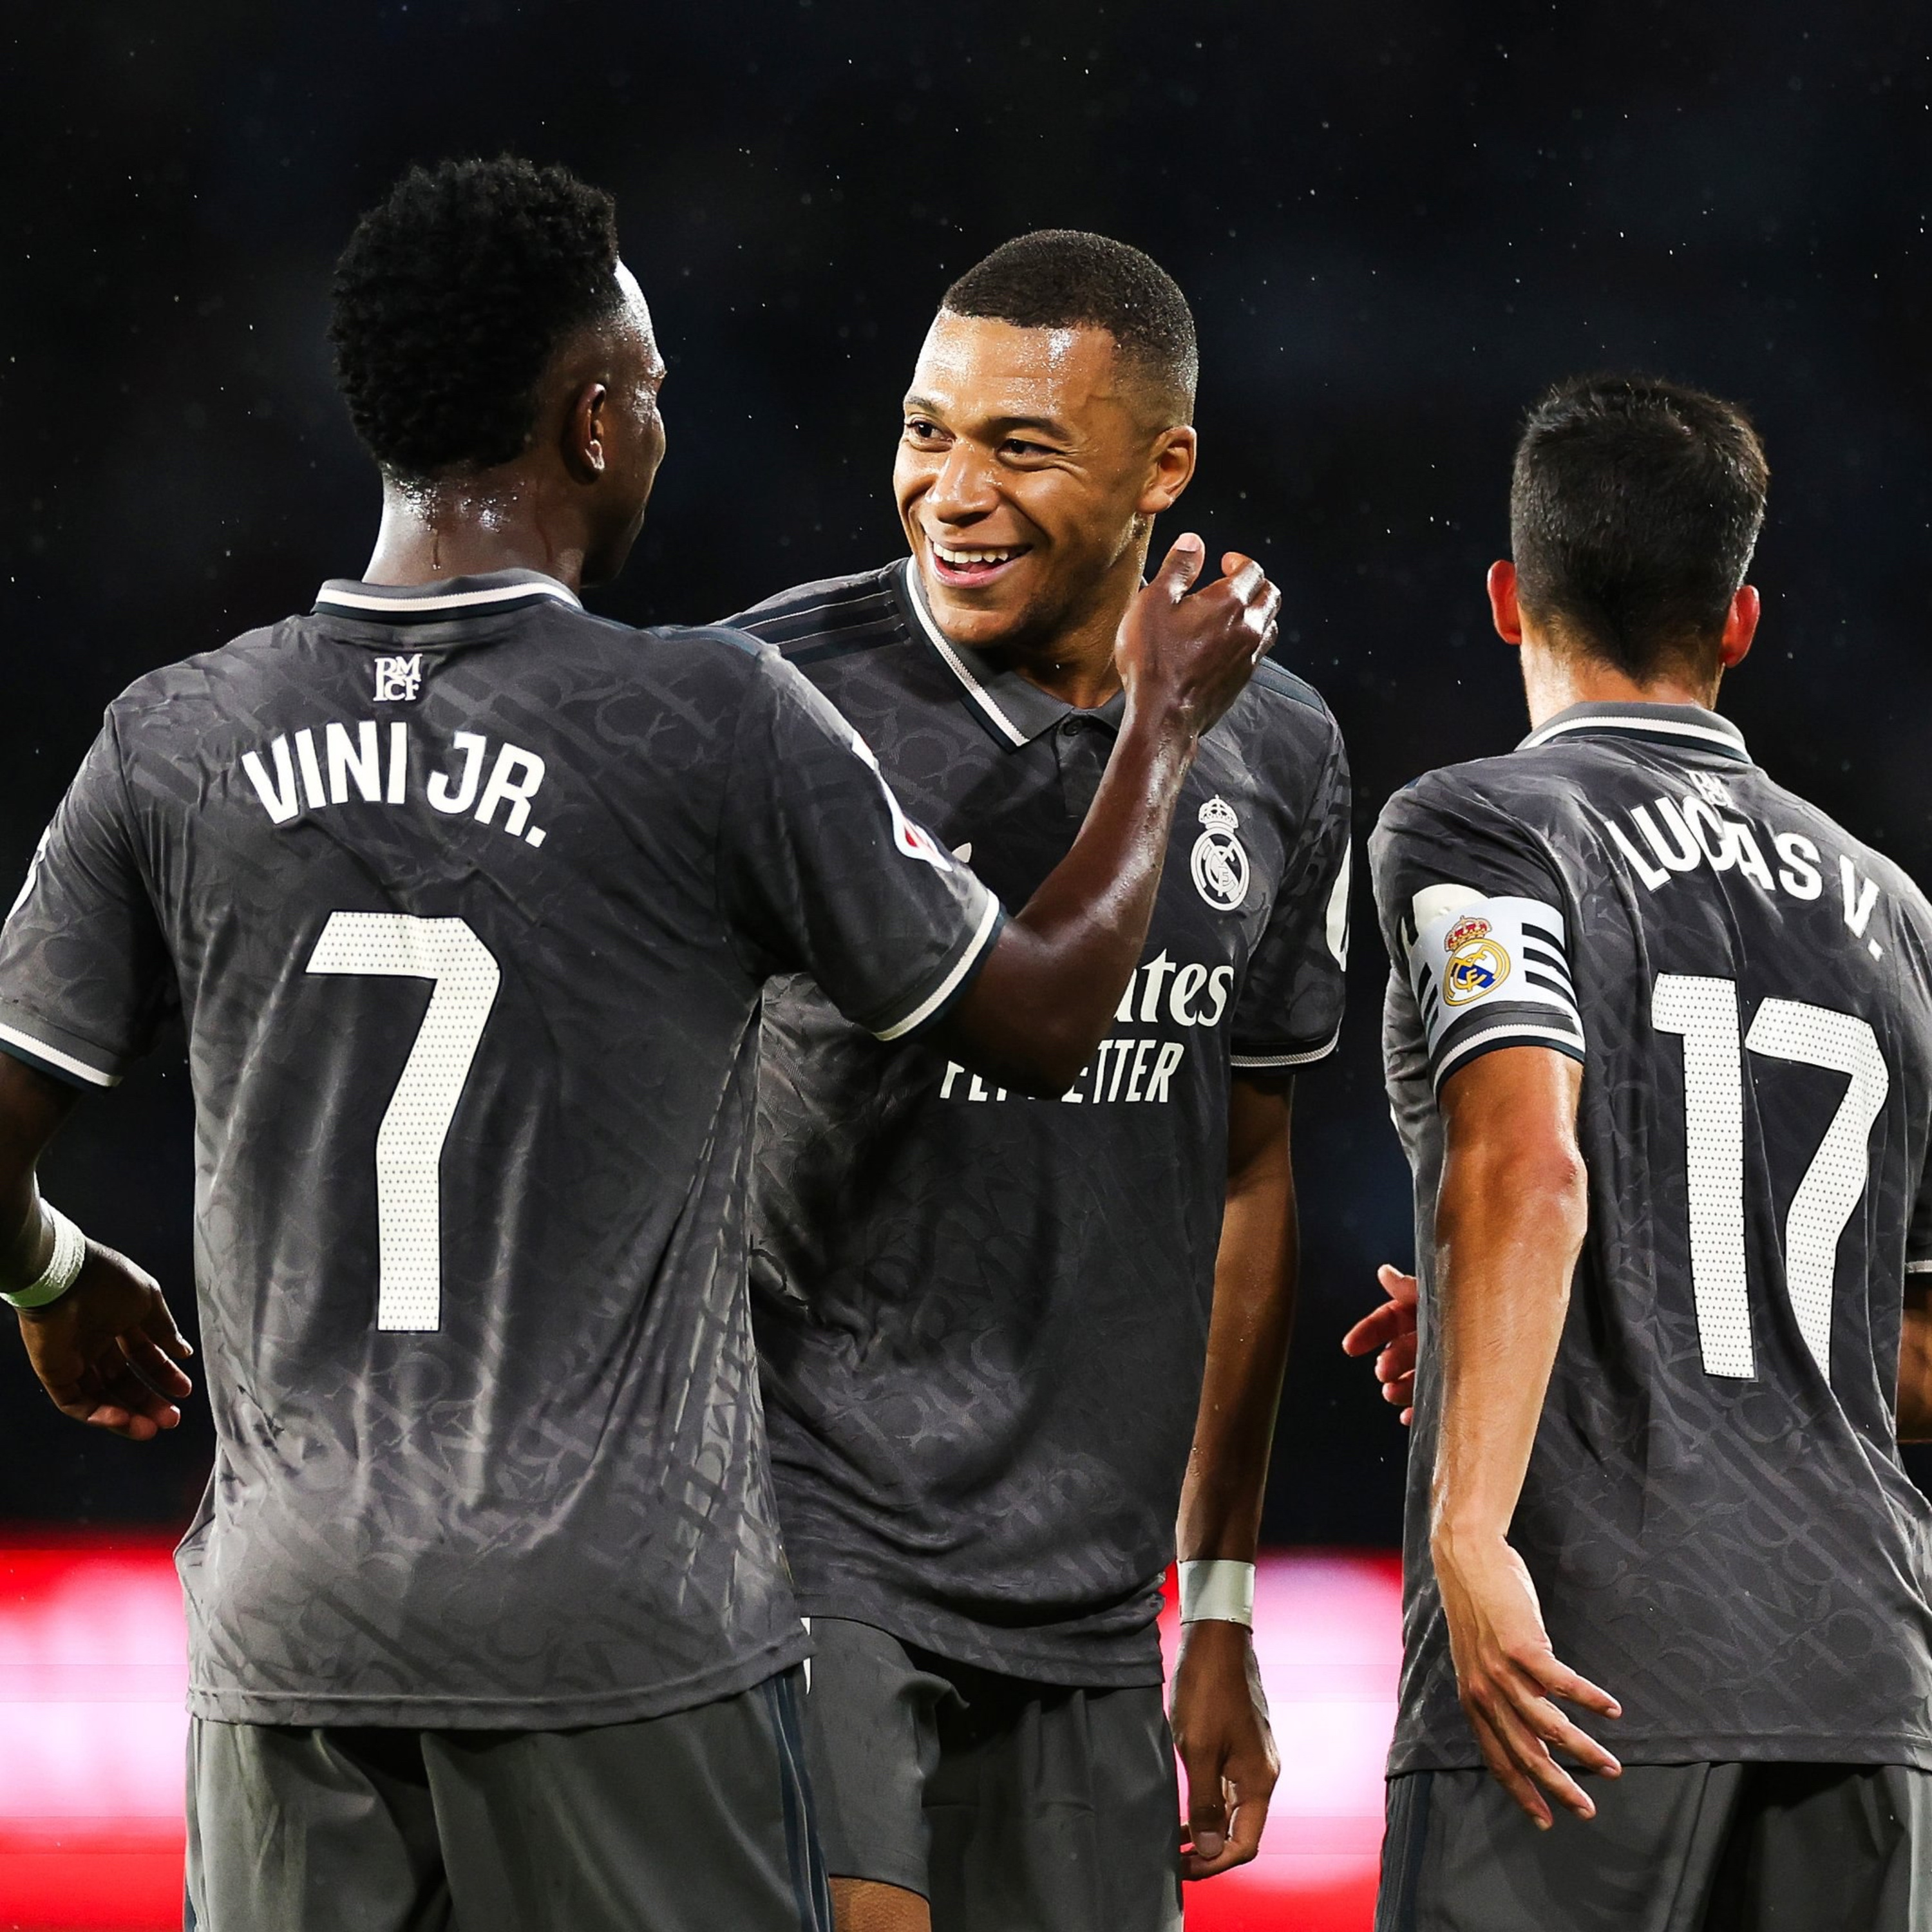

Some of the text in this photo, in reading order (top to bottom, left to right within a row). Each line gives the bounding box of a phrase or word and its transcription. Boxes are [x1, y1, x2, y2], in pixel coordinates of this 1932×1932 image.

[241, 720, 547, 848] VINI JR.
[1604, 795, 1884, 962] LUCAS V.
[305, 911, 501, 1332] 7
[1651, 972, 1889, 1388] 17
